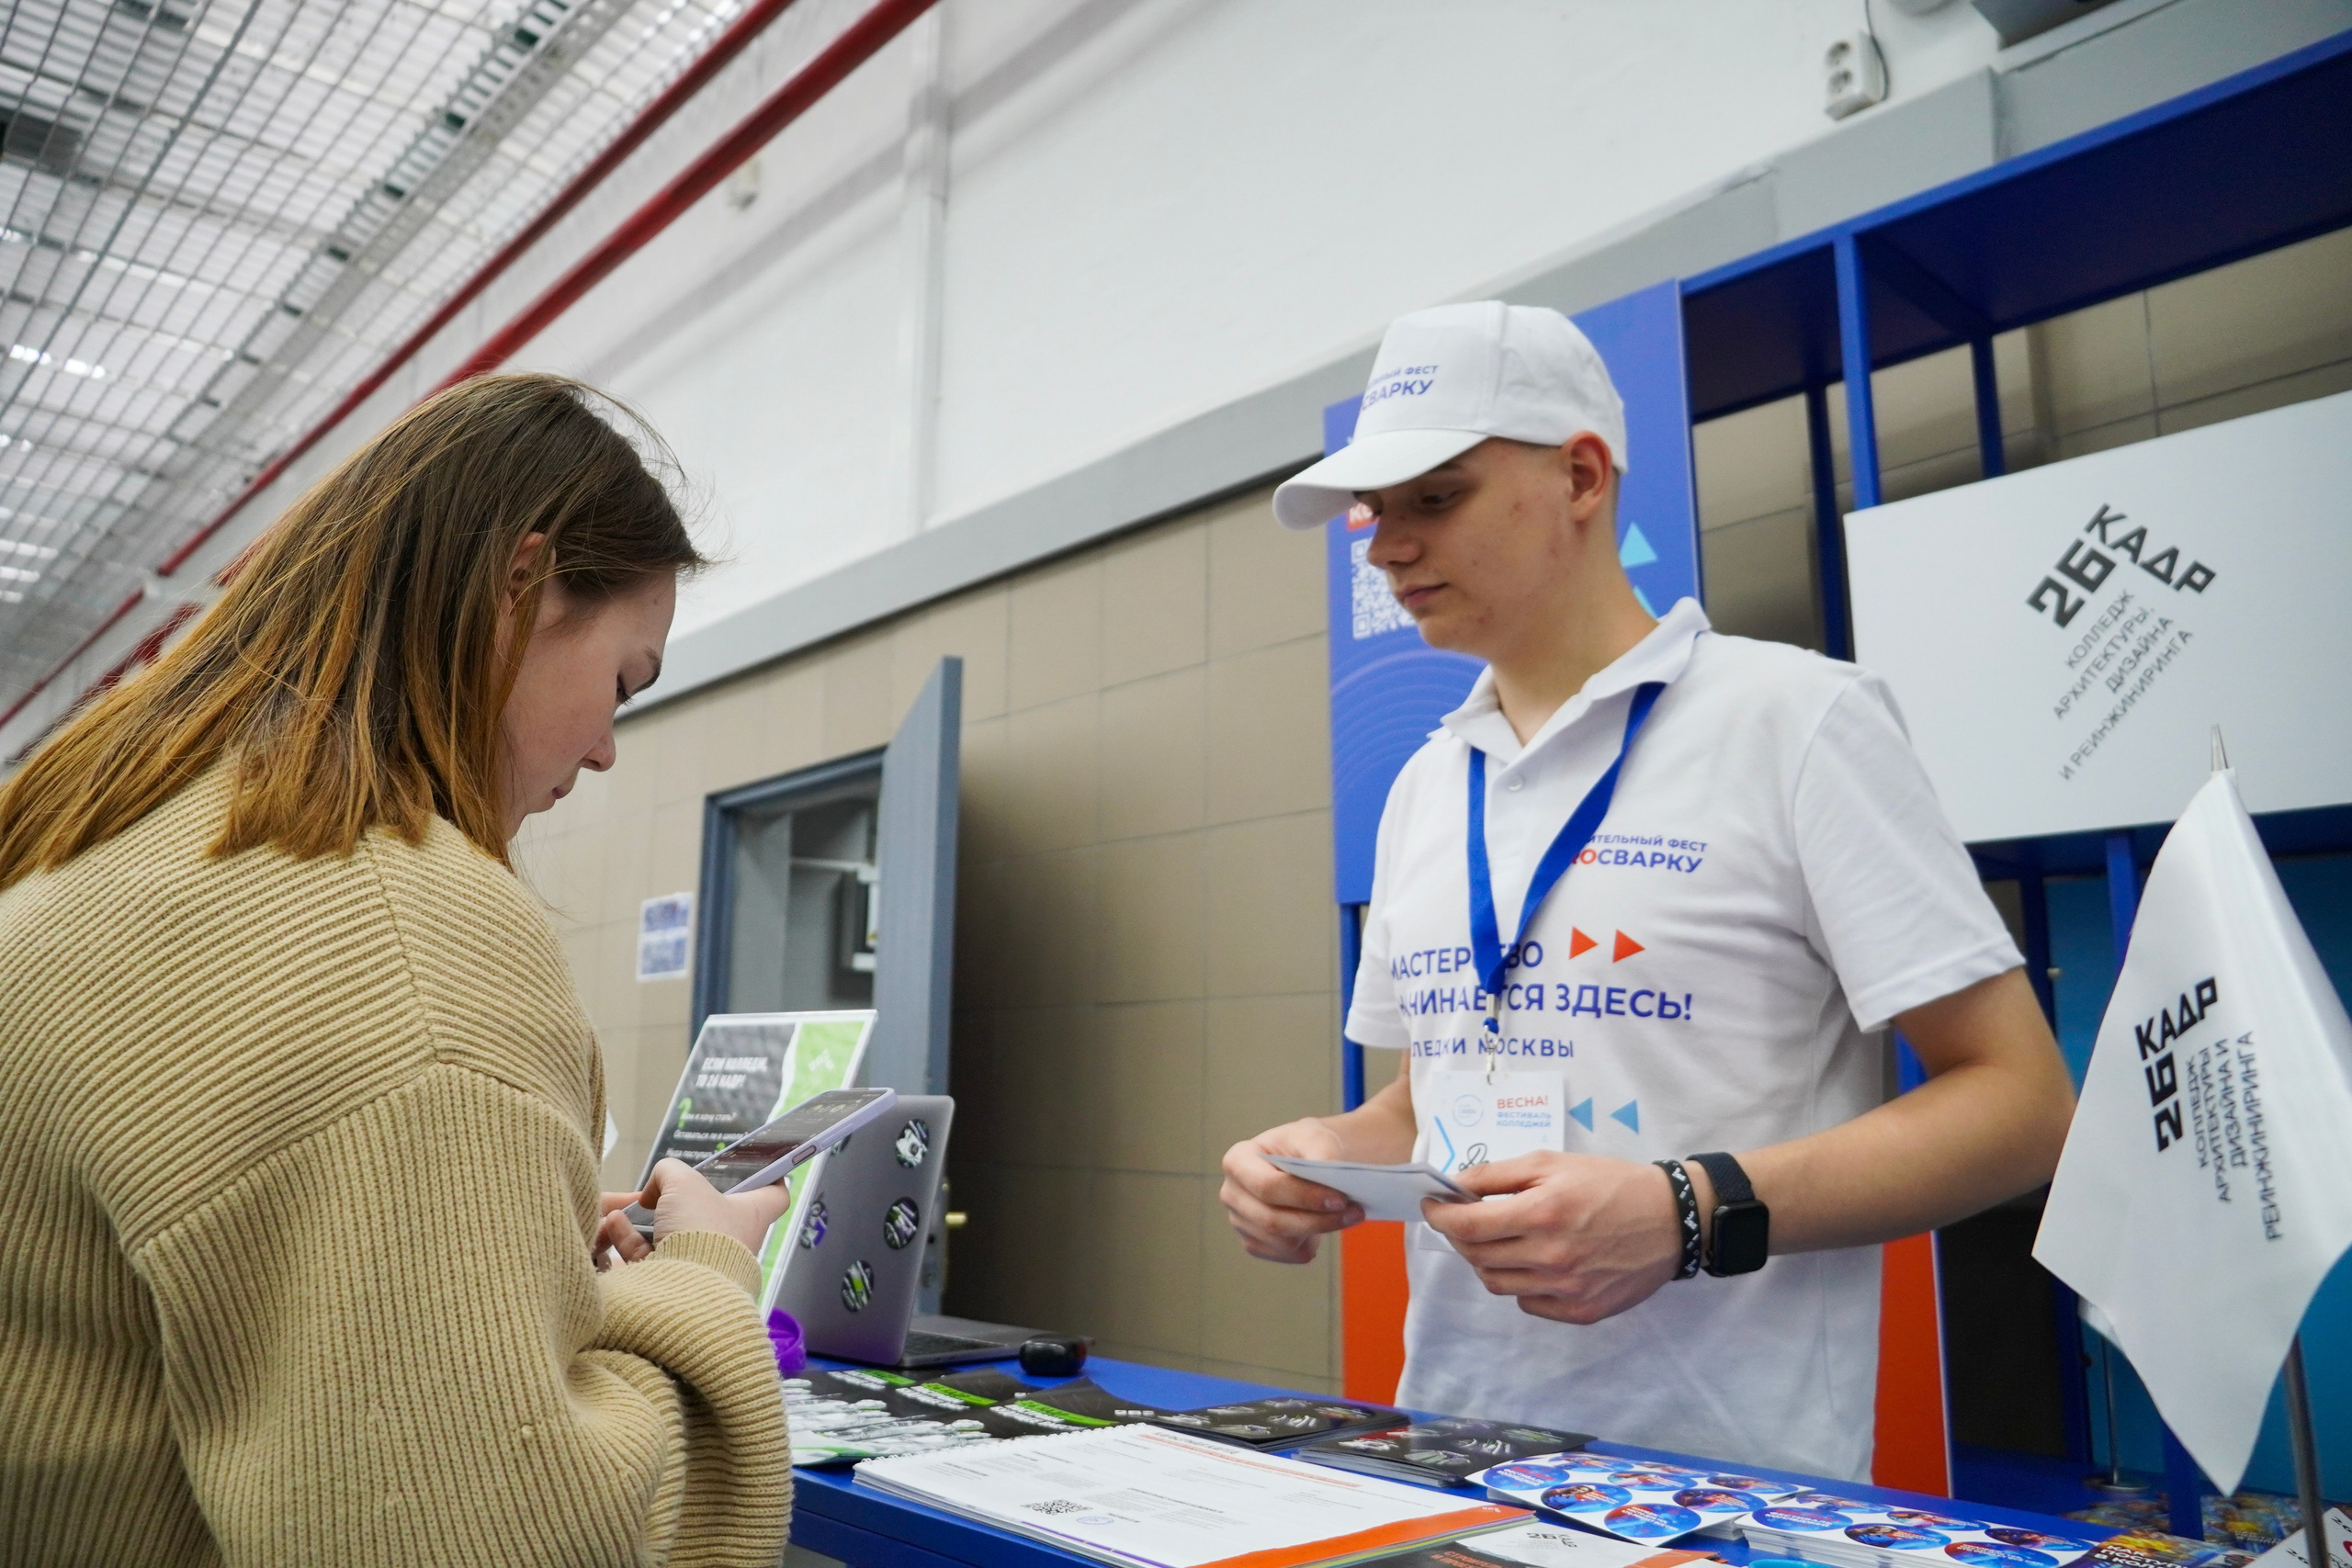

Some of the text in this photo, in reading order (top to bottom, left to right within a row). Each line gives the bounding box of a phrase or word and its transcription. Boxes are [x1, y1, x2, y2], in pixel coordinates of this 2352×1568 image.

[1405, 365, 1439, 376] ФЕСТ
[2084, 502, 2217, 595] КАДР
[2064, 589, 2136, 670] КОЛЛЕДЖ
[2105, 615, 2175, 694] ДИЗАЙНА
[2058, 764, 2074, 781] И
[1587, 834, 1707, 852] ИТЕЛЬНЫЙ ФЕСТ
[1572, 849, 1702, 874] ОСВАРКУ
[1555, 983, 1693, 1021] ЗДЕСЬ!
[2134, 976, 2218, 1061] КАДР
[2213, 1038, 2230, 1056] И
[1497, 1095, 1548, 1110] ВЕСНА!
[2185, 1054, 2207, 1168] КОЛЛЕДЖ
[1497, 1119, 1551, 1128] КОЛЛЕДЖЕЙ
[2111, 1557, 2165, 1568] КОЛ
